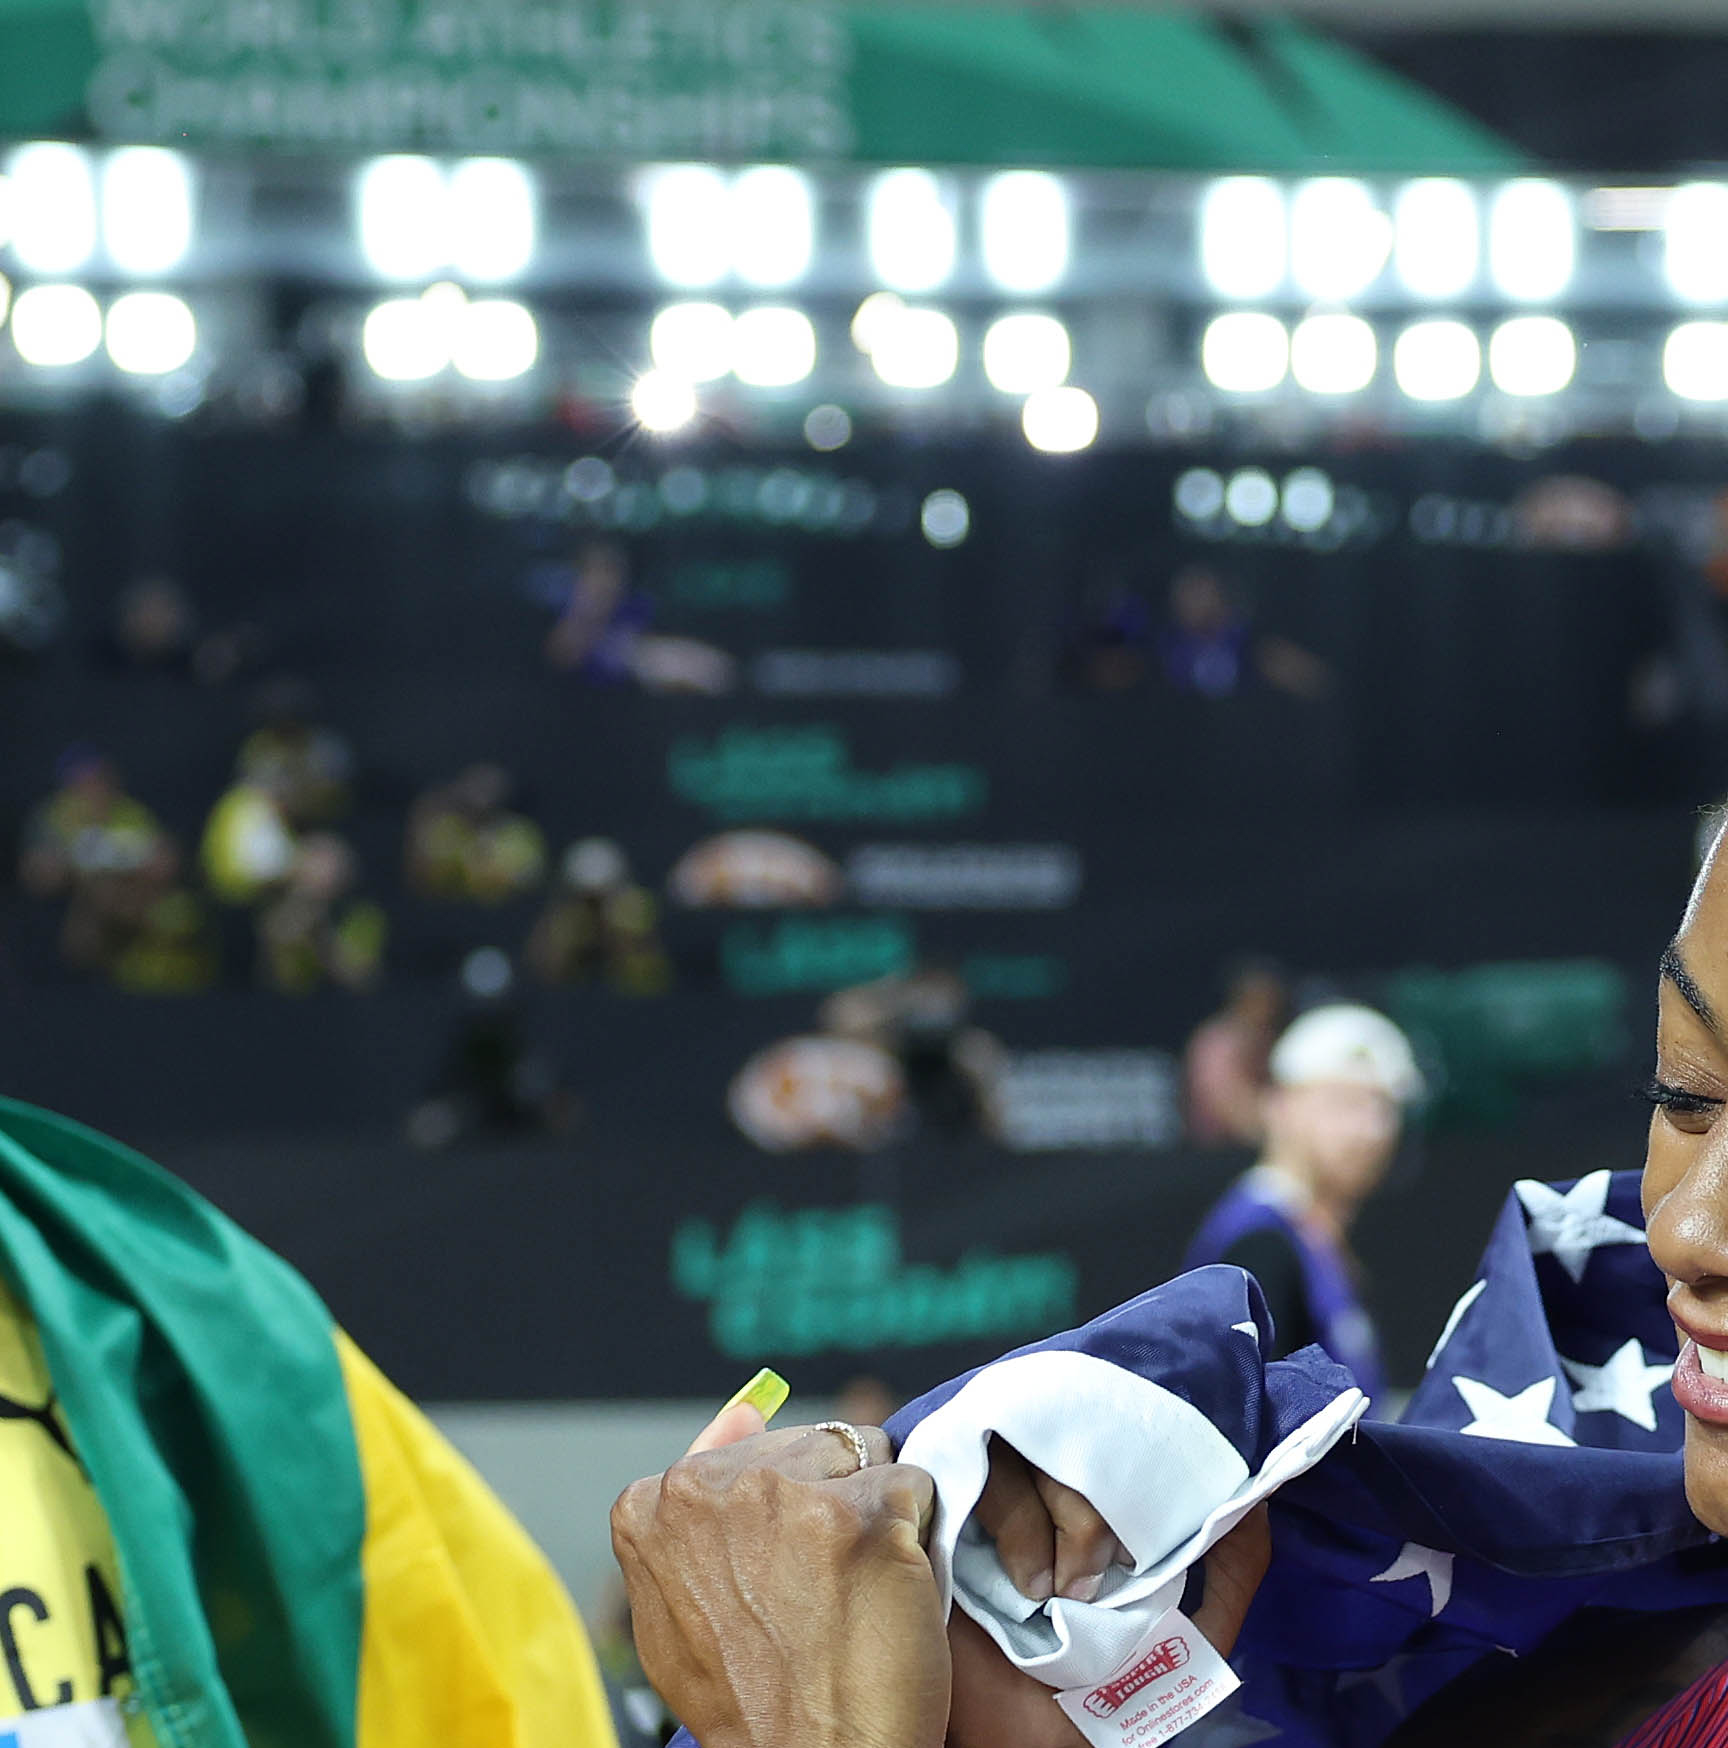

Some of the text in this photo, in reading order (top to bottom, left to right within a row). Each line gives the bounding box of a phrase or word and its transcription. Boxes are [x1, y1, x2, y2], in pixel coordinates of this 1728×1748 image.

[1120, 1710, 1148, 1731] Made
[1157, 1691, 1174, 1705] the
[1174, 1674, 1197, 1694] USA
